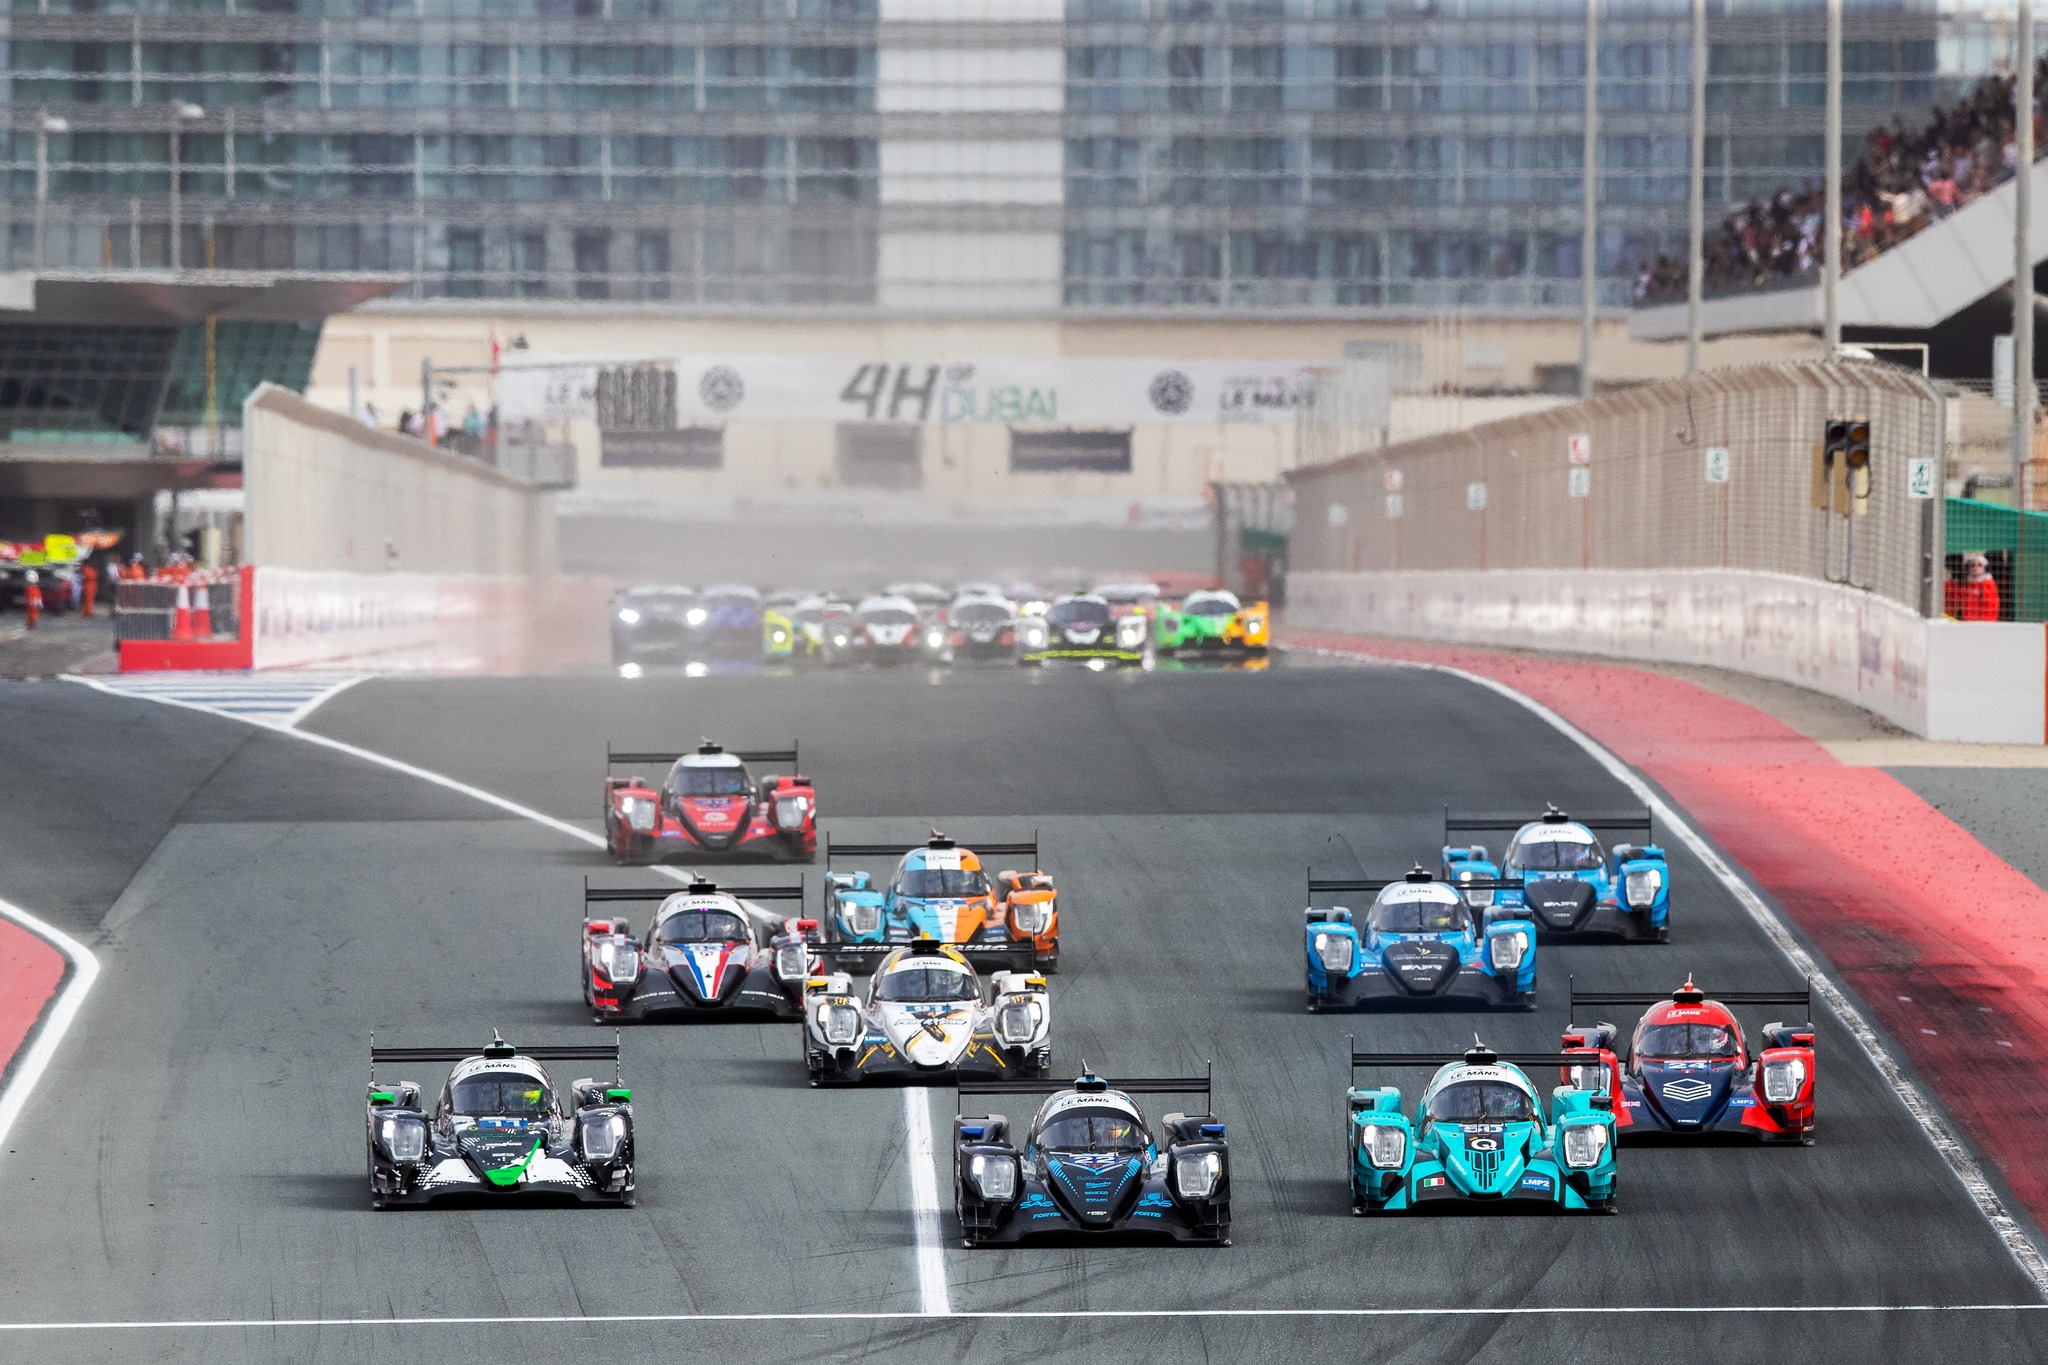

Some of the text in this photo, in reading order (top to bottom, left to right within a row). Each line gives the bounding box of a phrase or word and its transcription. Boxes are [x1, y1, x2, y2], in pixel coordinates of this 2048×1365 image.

[841, 363, 940, 421] 4H
[941, 384, 1057, 423] DUBAI
[1522, 1179, 1550, 1187] LMP2
[1020, 1200, 1055, 1209] SAS
[1138, 1199, 1173, 1208] SAS
[1032, 1211, 1061, 1219] FORTIS
[1133, 1210, 1162, 1218] FORTIS
